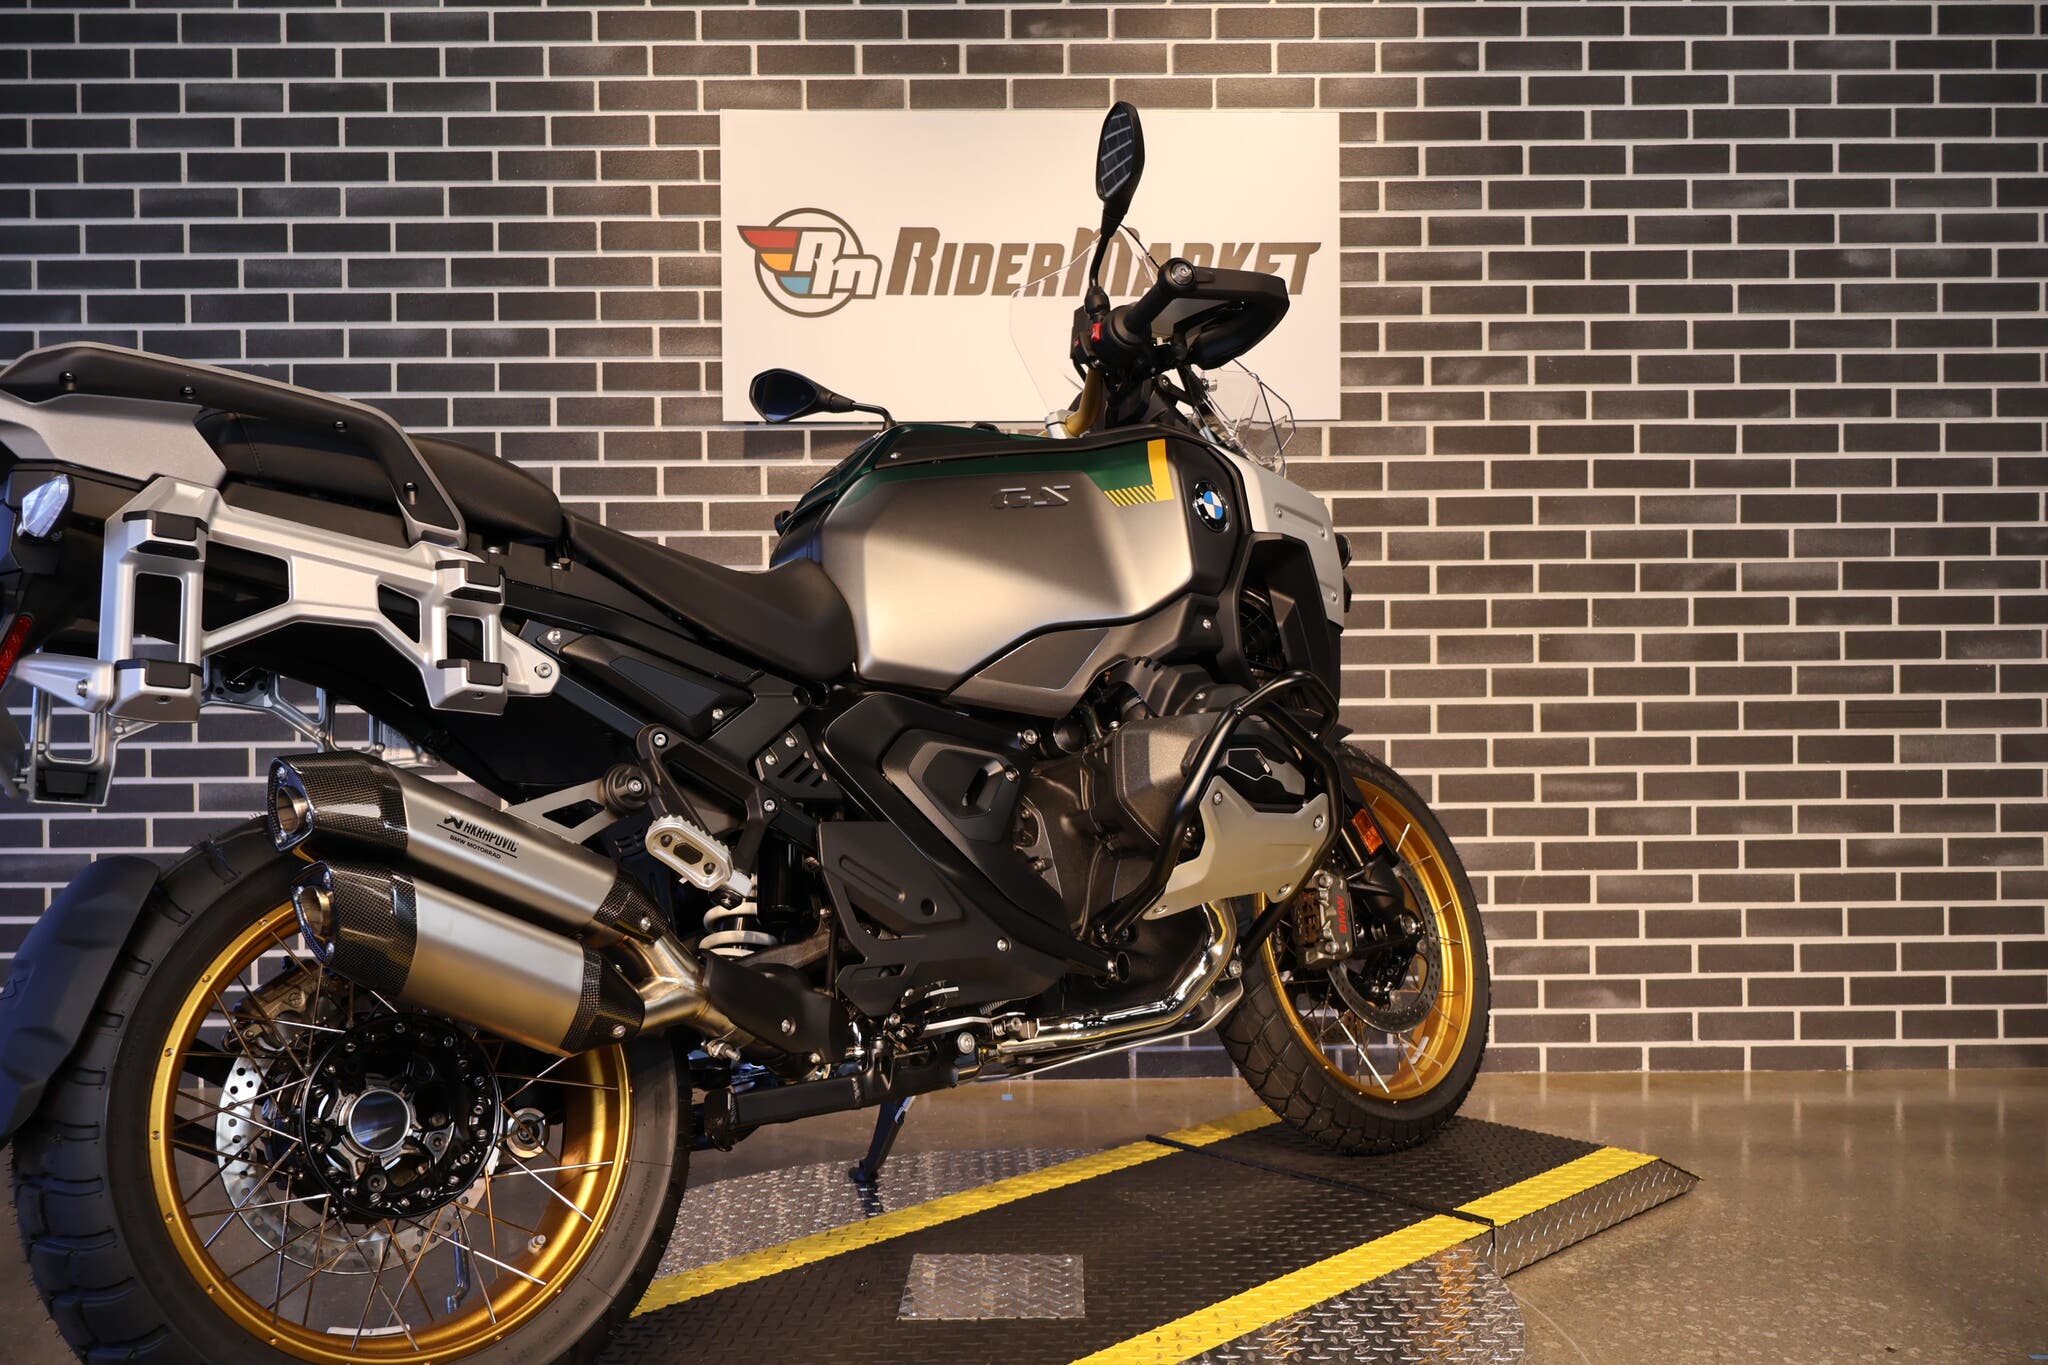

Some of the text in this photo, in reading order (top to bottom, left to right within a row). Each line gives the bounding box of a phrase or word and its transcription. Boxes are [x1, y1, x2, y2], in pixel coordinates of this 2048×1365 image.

[450, 834, 502, 859] BMW MOTORRAD
[1336, 895, 1348, 934] BMW
